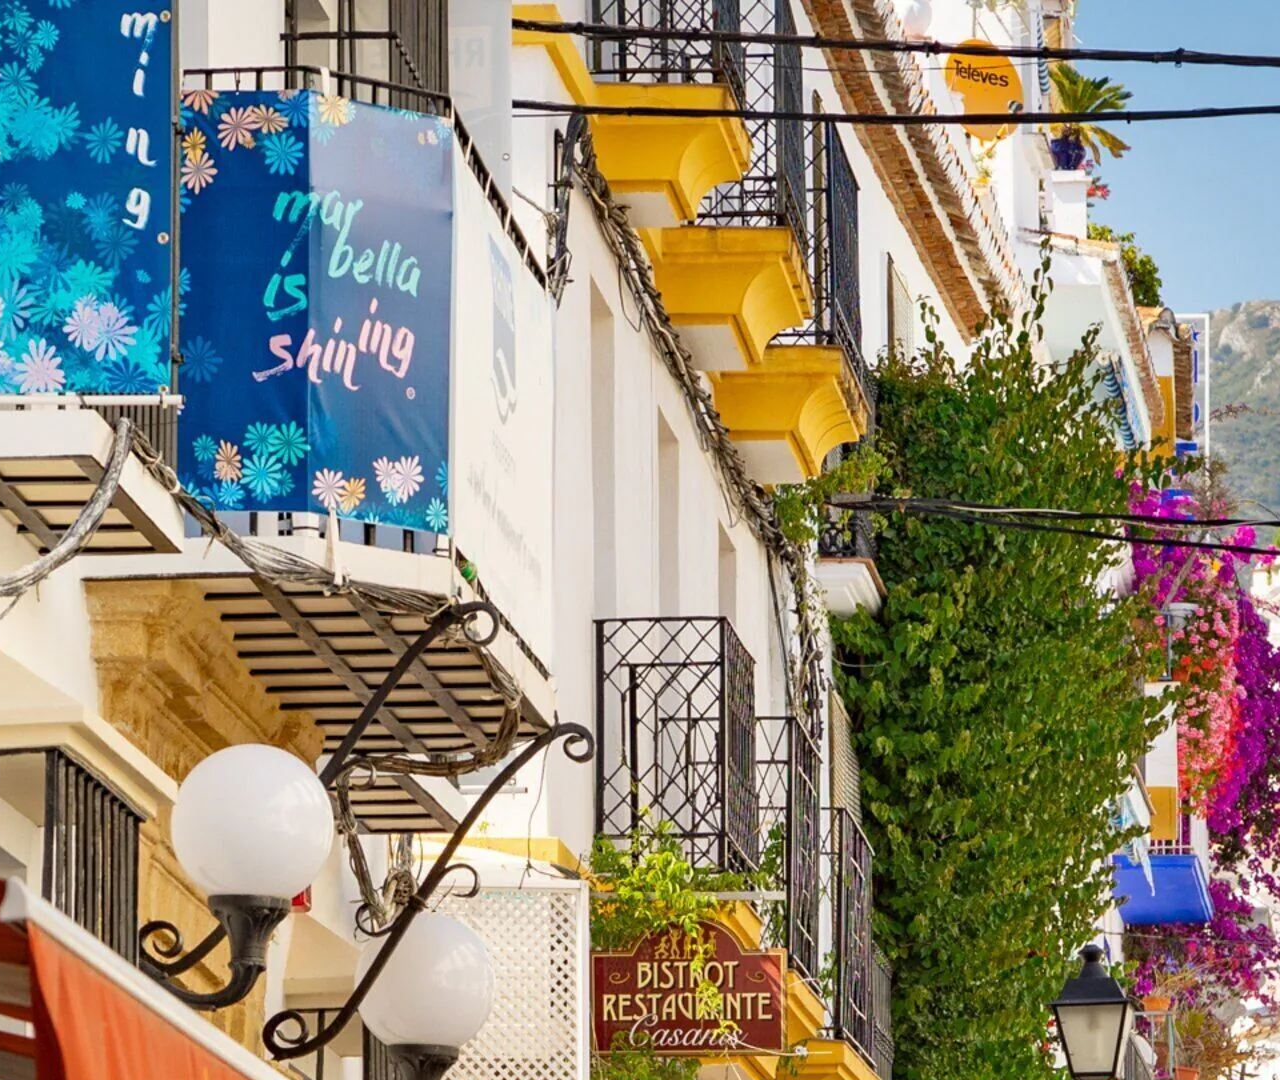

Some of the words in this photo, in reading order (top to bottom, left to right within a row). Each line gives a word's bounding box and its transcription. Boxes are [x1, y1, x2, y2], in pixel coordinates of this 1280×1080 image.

[953, 59, 1009, 87] Televes
[272, 190, 364, 232] mar
[263, 251, 308, 322] is
[327, 238, 422, 298] bella
[636, 961, 739, 989] BISTROT
